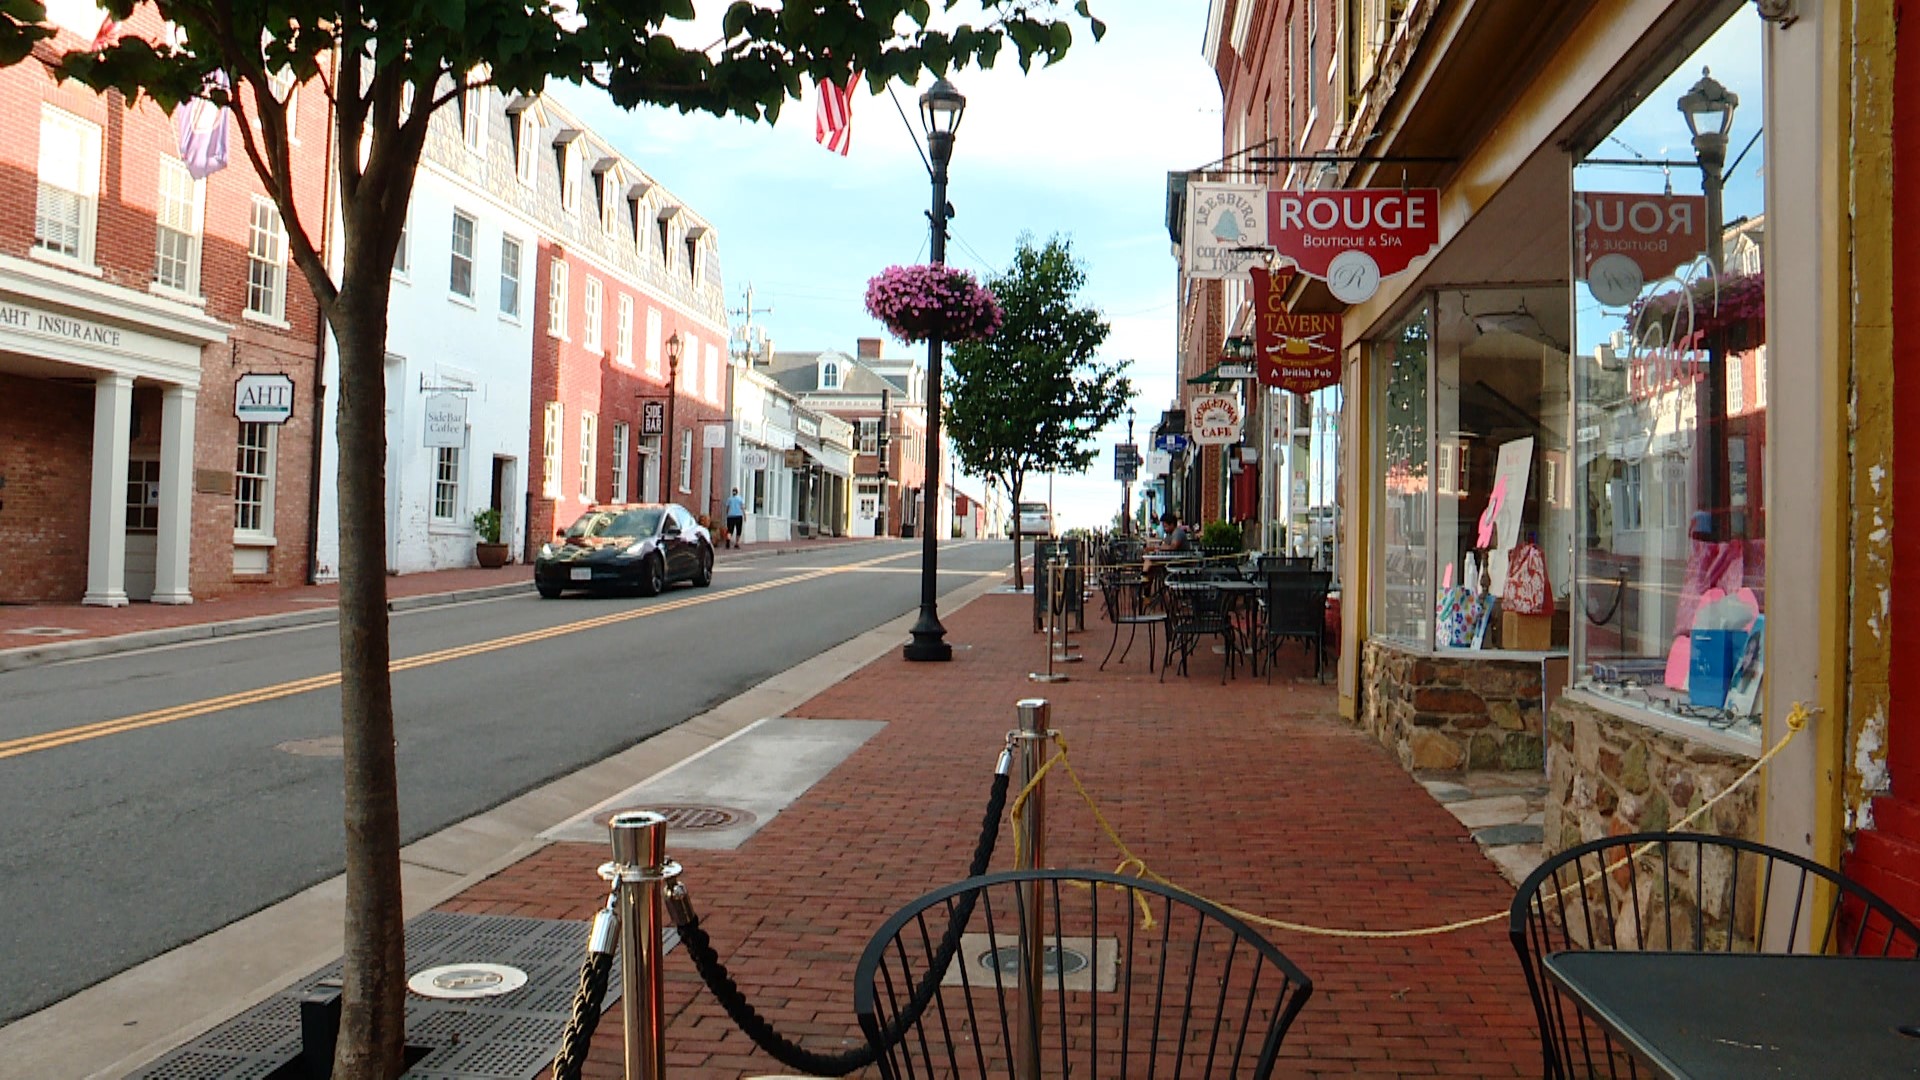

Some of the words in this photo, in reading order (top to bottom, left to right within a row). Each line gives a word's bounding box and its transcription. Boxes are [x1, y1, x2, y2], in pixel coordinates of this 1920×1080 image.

[1197, 193, 1256, 228] LEESBURG
[1280, 197, 1426, 230] ROUGE
[1303, 233, 1364, 247] BOUTIQUE
[1368, 237, 1377, 246] &
[1380, 233, 1402, 246] SPA
[1212, 259, 1239, 271] INN
[0, 307, 30, 326] AHT
[37, 315, 121, 346] INSURANCE
[1264, 314, 1335, 332] TAVERN
[1271, 368, 1279, 378] A
[1314, 368, 1332, 378] Pub
[1632, 329, 1705, 403] ROUGE
[241, 385, 289, 405] AHT
[428, 411, 462, 422] SideBar
[645, 405, 662, 418] SIDE
[430, 423, 460, 433] Coffee
[645, 418, 662, 432] BAR
[1201, 427, 1232, 437] CAFE
